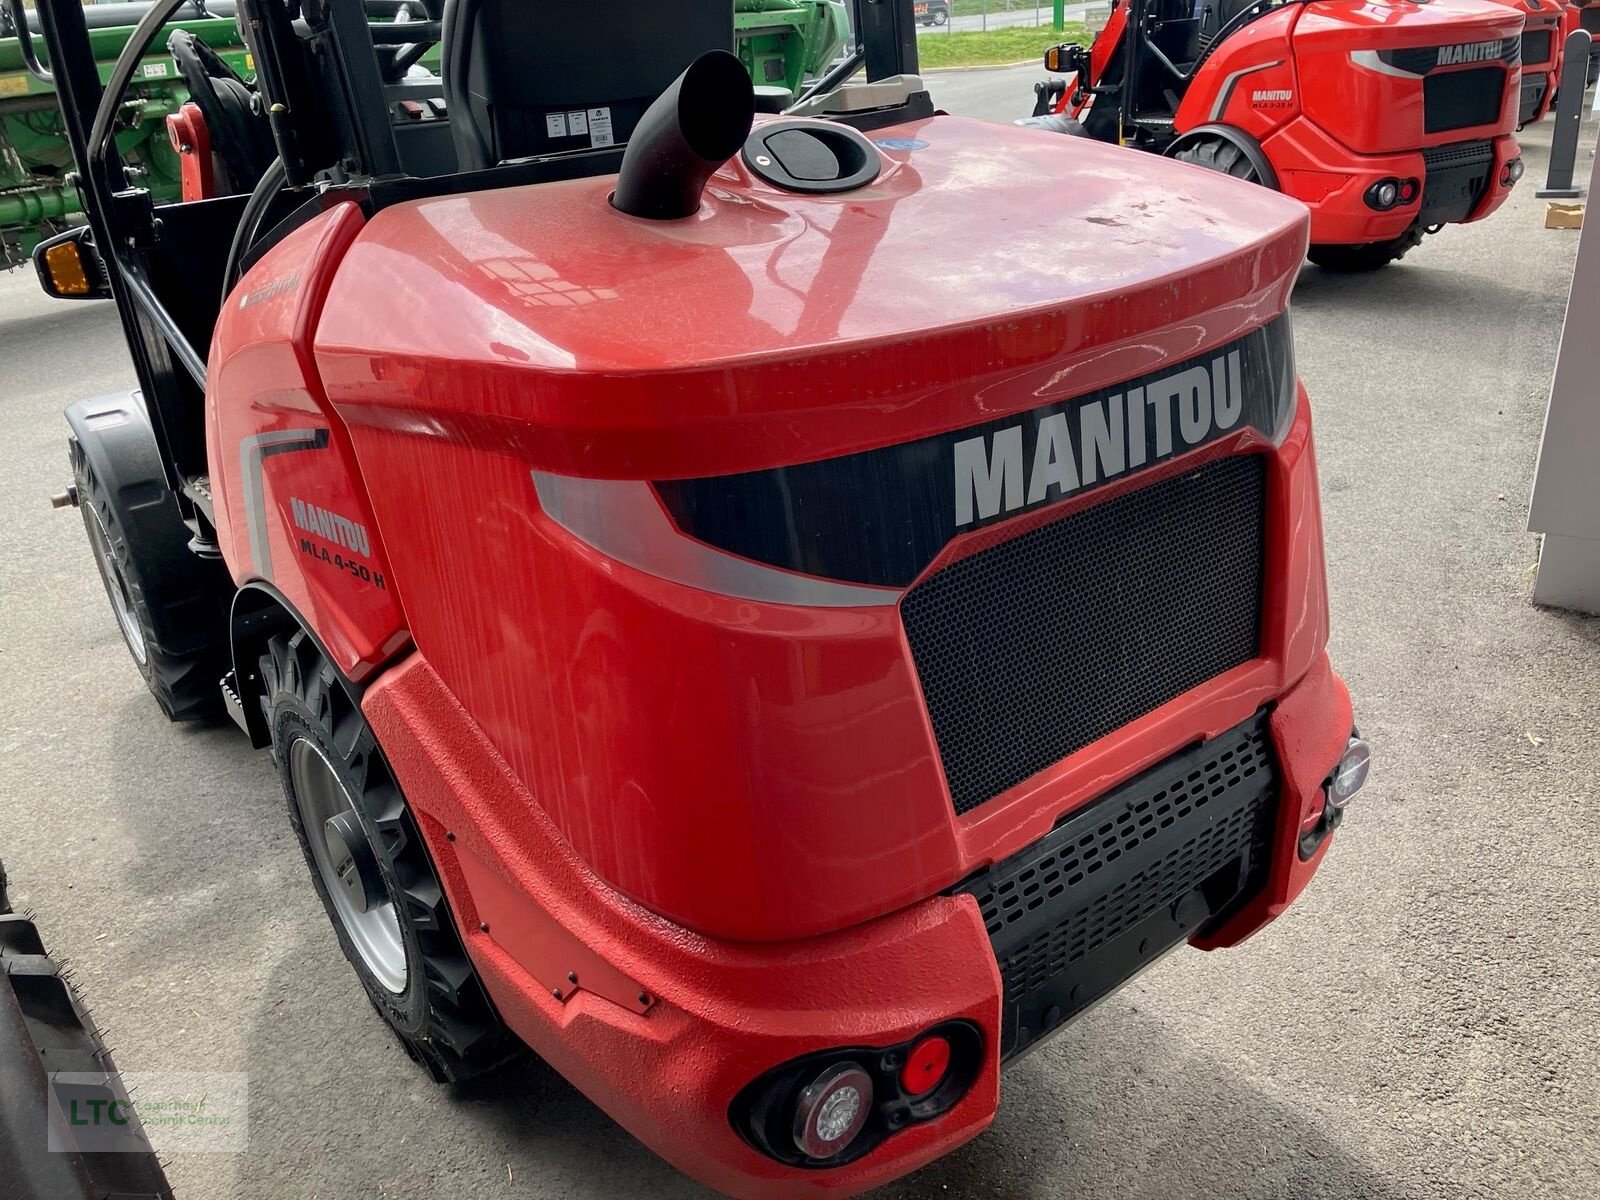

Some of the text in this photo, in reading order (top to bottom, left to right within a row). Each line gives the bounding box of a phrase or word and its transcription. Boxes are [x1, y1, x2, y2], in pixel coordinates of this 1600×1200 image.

[1437, 40, 1503, 65] MANITOU
[1252, 90, 1293, 101] MANITOU
[952, 348, 1243, 528] MANITOU
[289, 496, 371, 558] MANITOU
[300, 538, 386, 591] MLA 4-50 H
